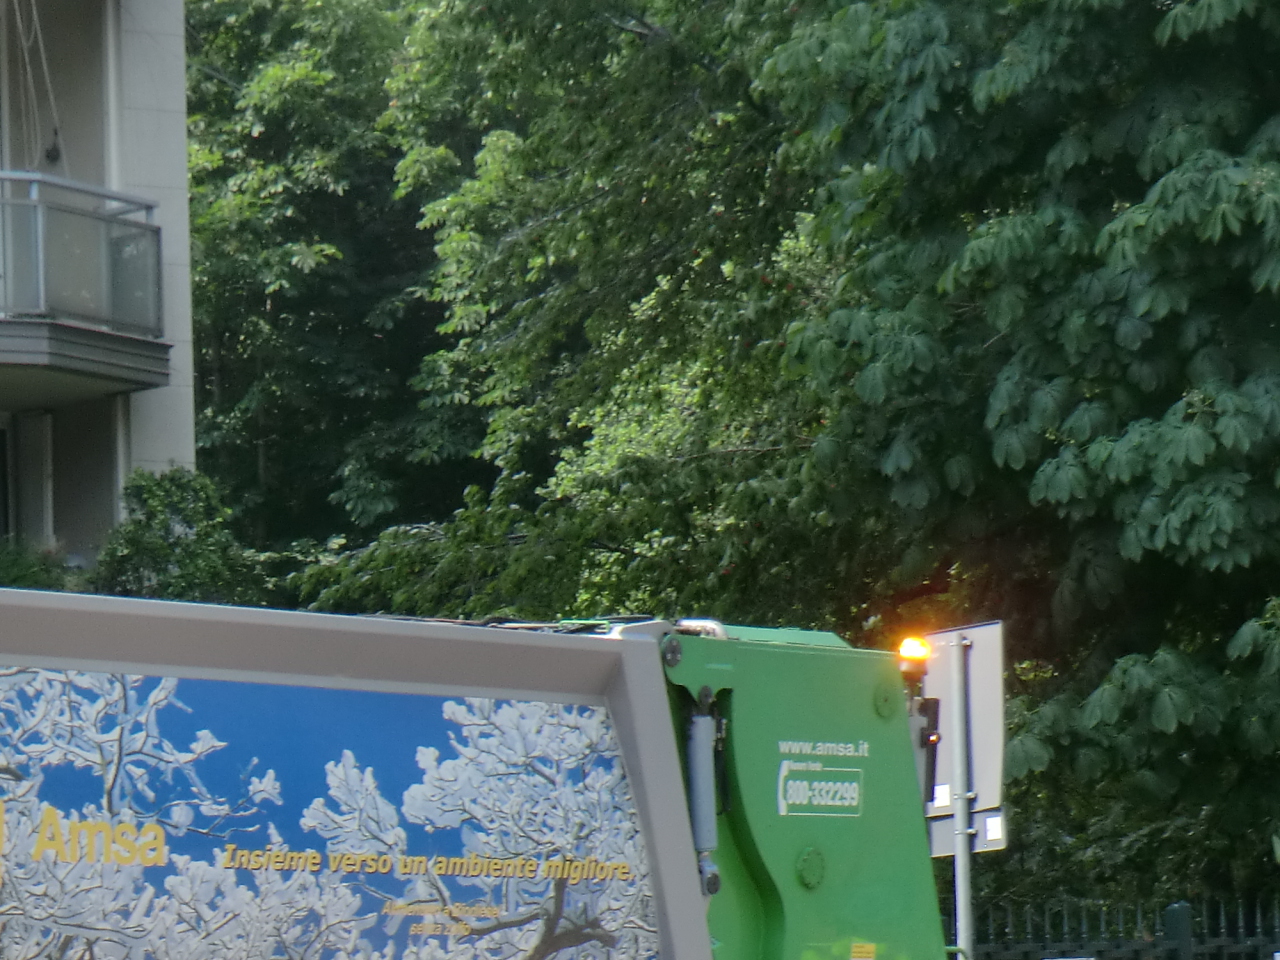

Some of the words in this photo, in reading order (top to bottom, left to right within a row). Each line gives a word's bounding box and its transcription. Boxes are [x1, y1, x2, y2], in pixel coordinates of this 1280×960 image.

[778, 740, 869, 757] www.amsa.it
[32, 806, 166, 867] Amsa
[223, 843, 322, 872] Insieme
[328, 852, 393, 875] verso
[398, 855, 429, 875] un
[434, 850, 538, 878] ambiente
[543, 855, 636, 885] migliore.
